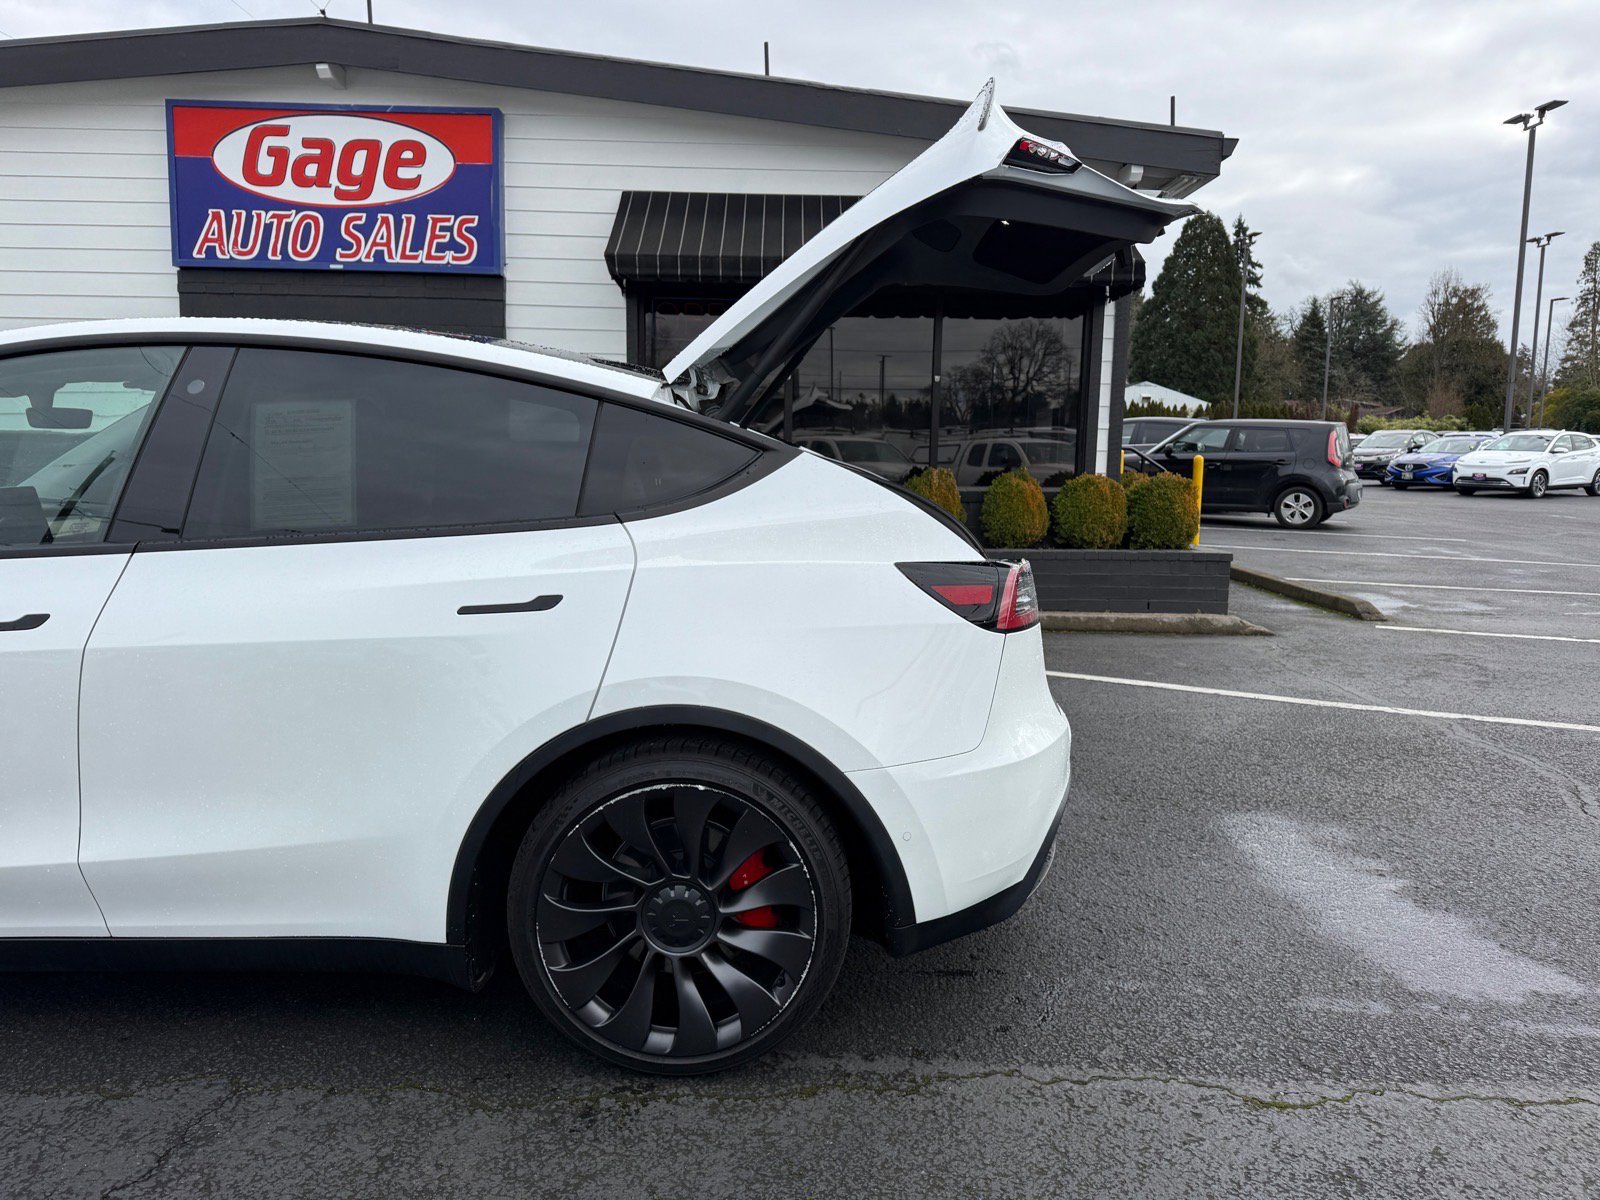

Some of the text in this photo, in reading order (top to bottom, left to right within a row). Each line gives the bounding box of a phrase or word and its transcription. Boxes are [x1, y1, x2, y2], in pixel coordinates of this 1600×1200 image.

[242, 124, 427, 201] Gage
[193, 209, 479, 265] AUTO SALES
